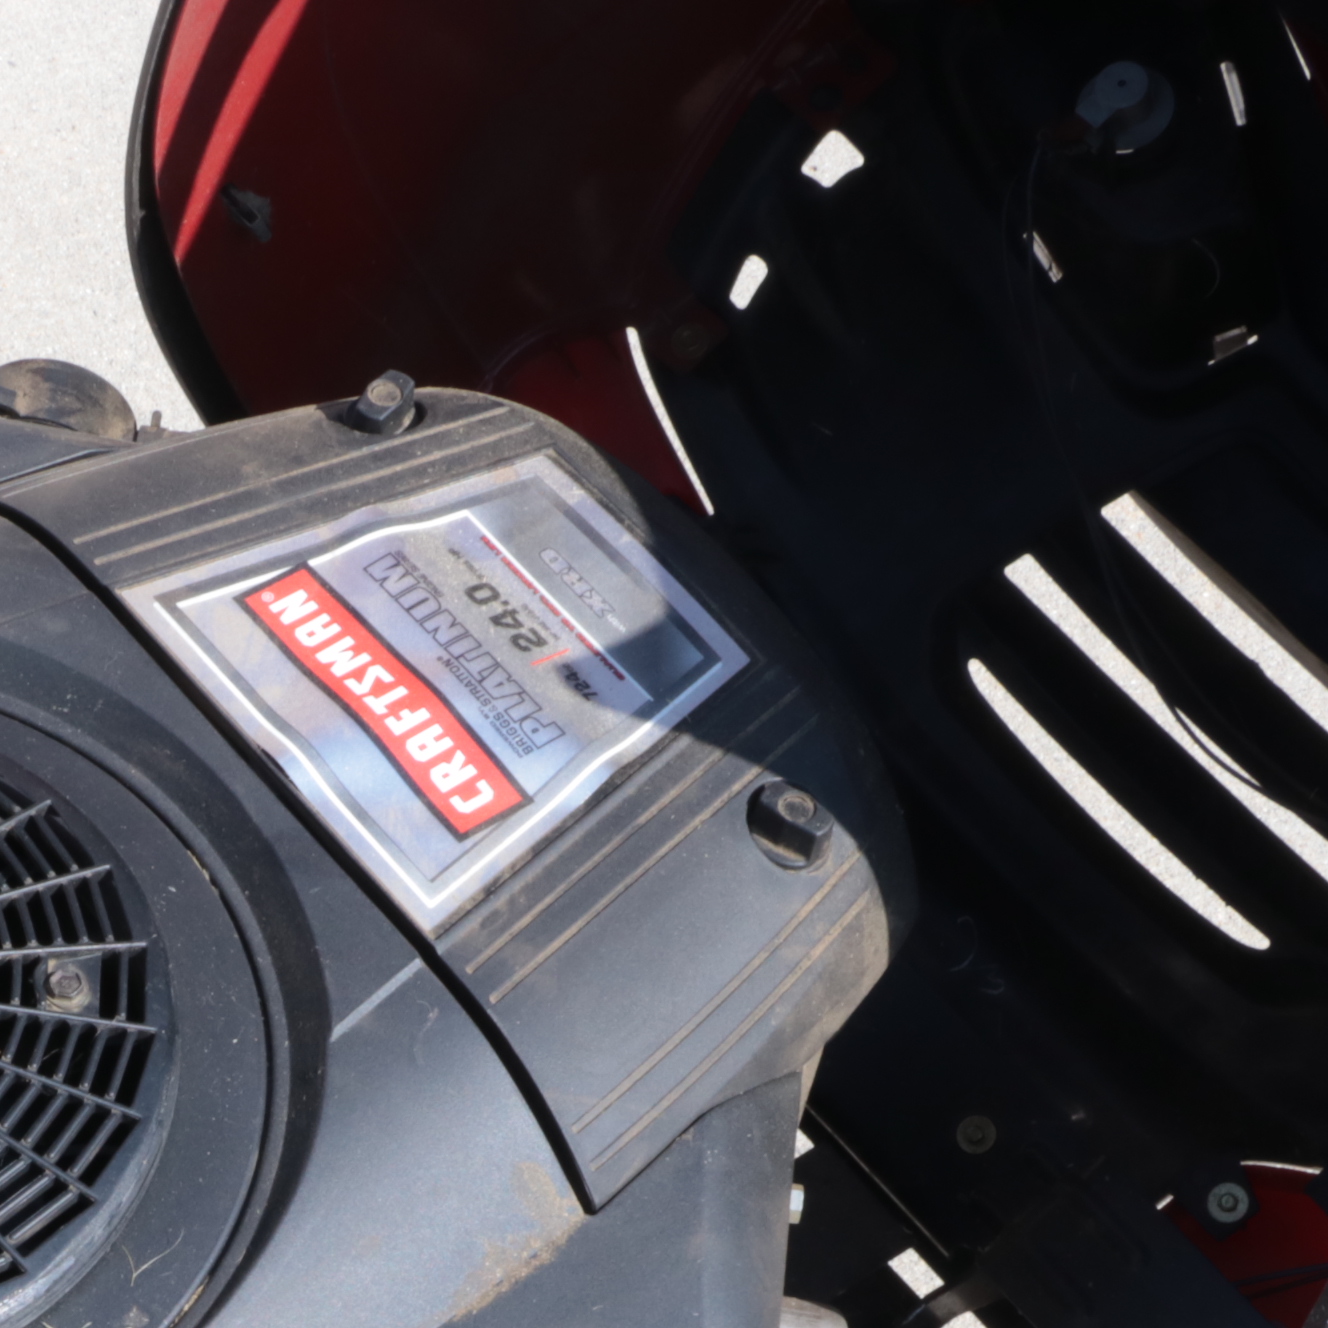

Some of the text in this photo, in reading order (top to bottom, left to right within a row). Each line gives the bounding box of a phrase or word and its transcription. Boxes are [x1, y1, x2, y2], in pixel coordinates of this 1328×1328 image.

[462, 581, 547, 654] 24.0
[534, 547, 615, 617] XRD
[360, 555, 564, 749] PLATINUM
[269, 589, 495, 813] CRAFTSMAN
[492, 711, 534, 754] BRIGGS
